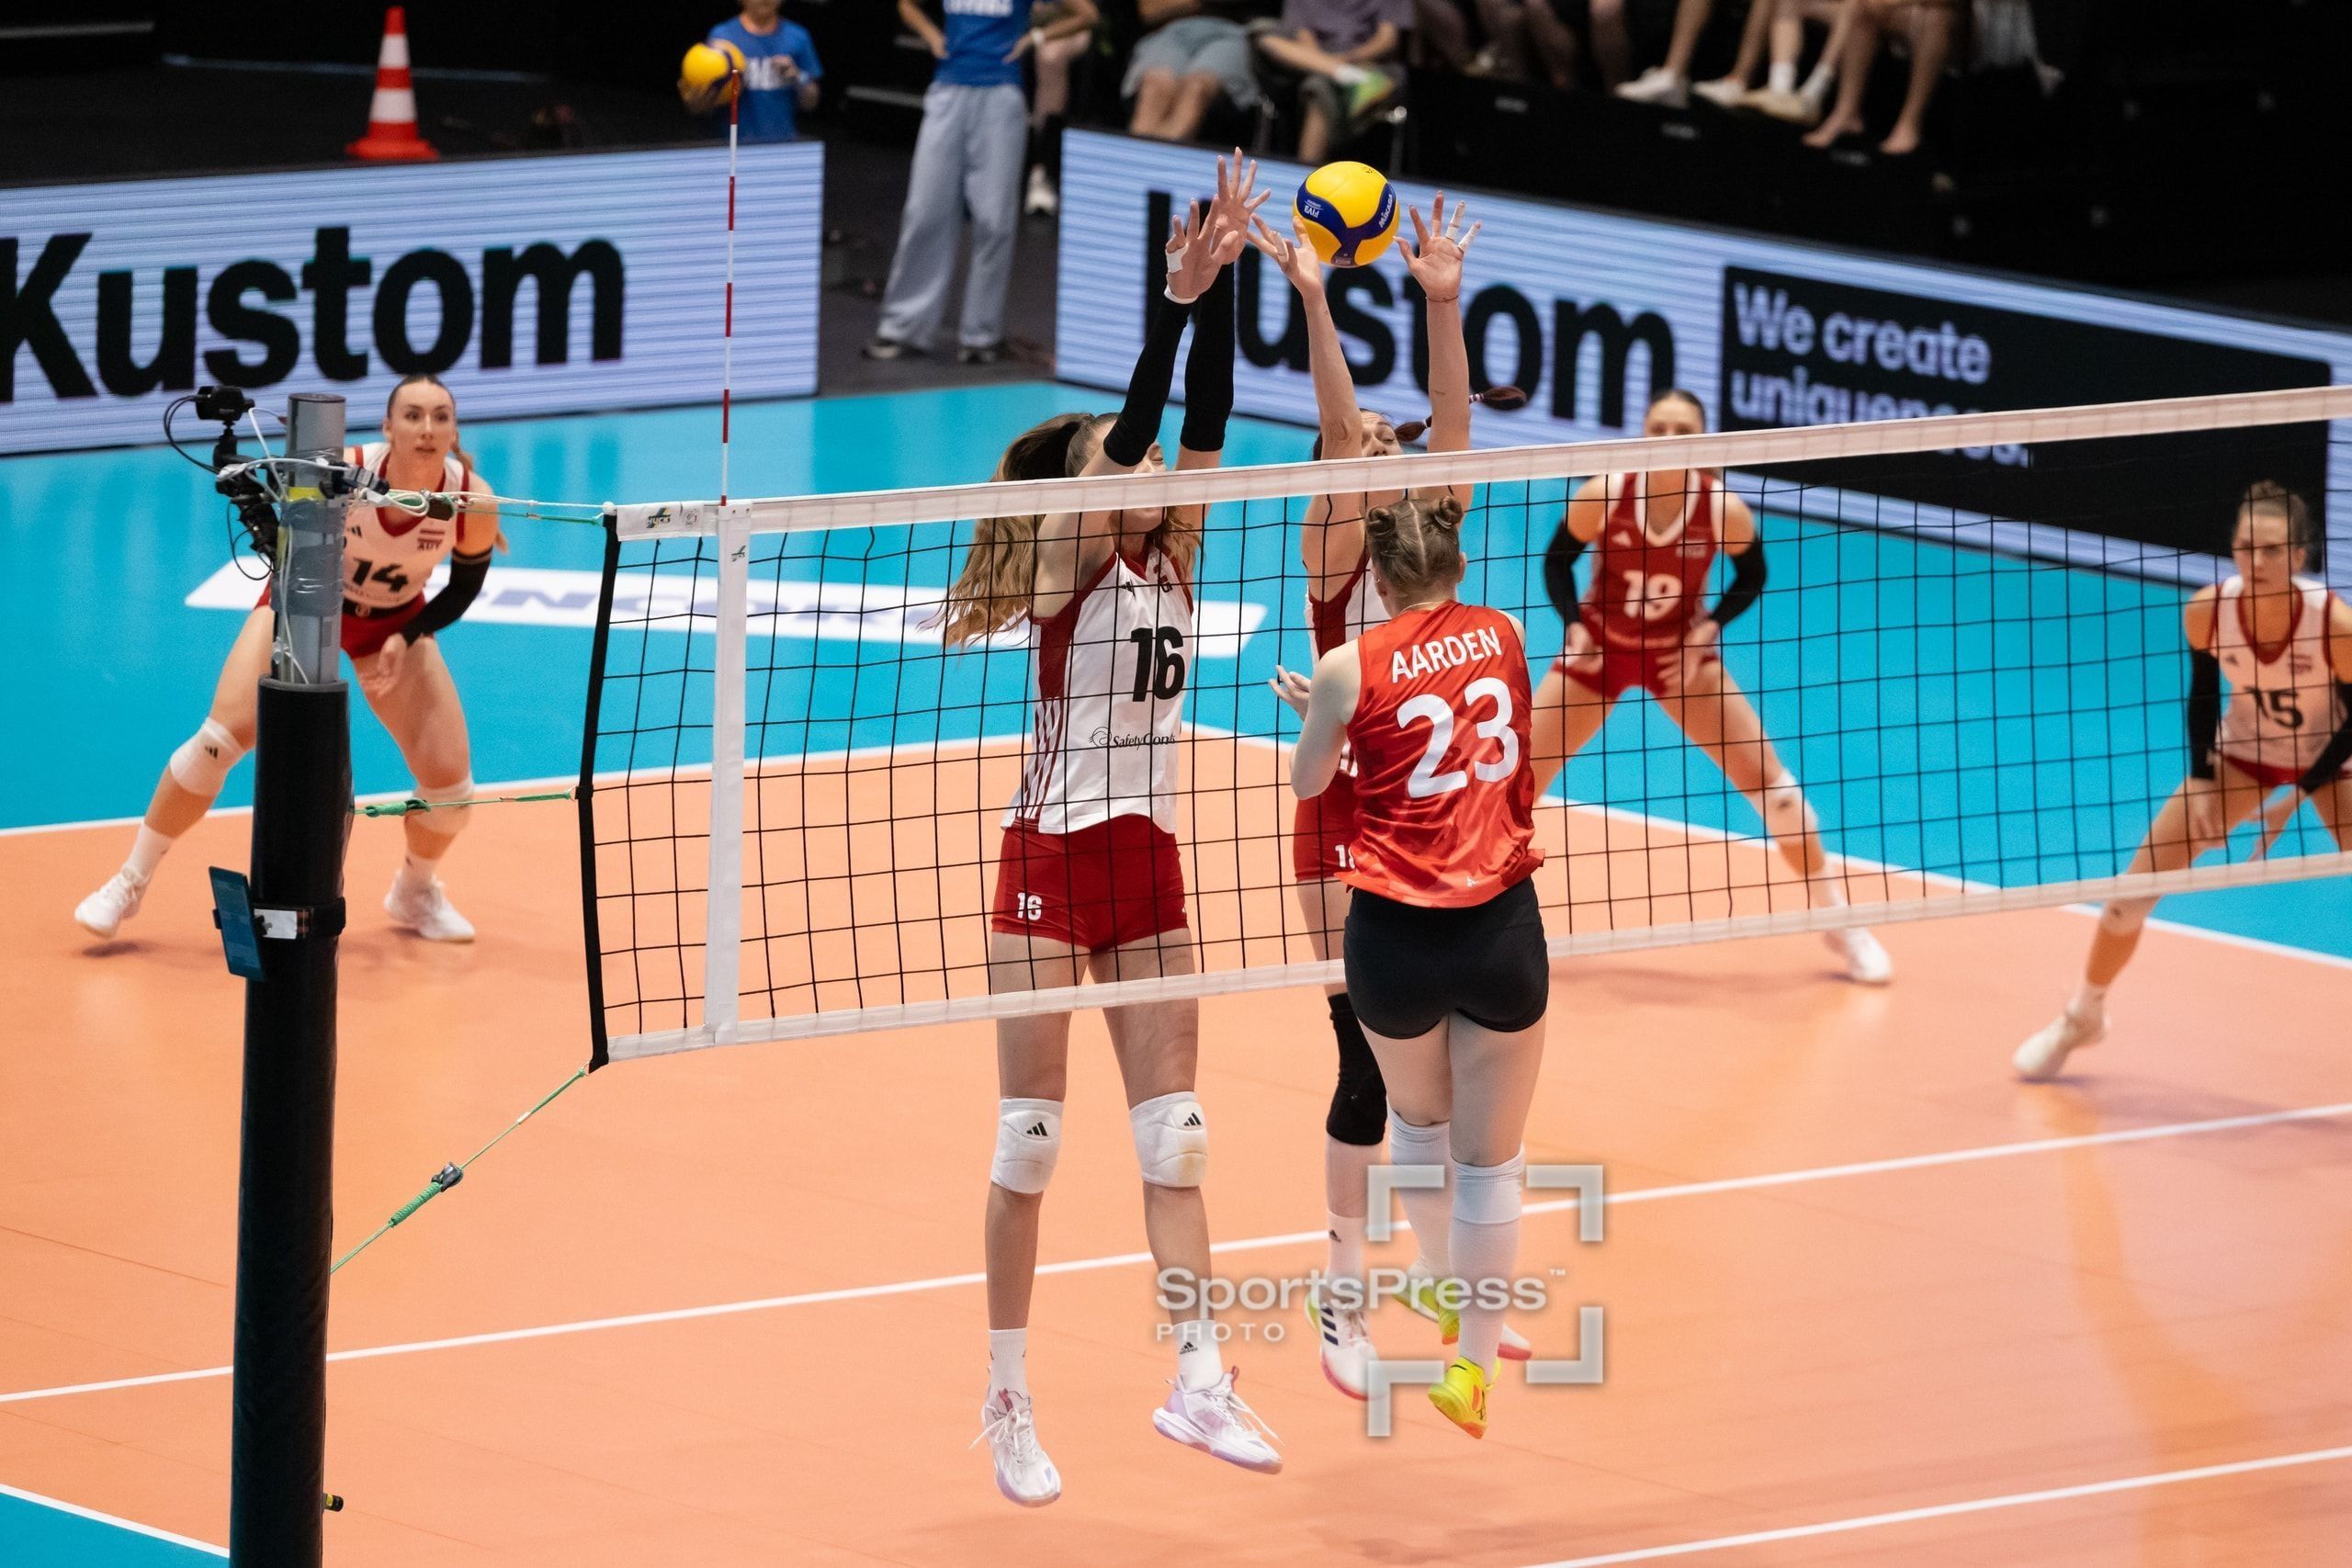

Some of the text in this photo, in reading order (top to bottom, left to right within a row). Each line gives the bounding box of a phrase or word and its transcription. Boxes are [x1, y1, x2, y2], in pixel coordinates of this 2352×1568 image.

[1304, 204, 1320, 219] FIVB
[0, 226, 625, 403] Kustom
[1733, 281, 1992, 384] We create
[353, 557, 408, 593] 14
[1623, 570, 1683, 622] 19
[1131, 626, 1185, 703] 16
[1392, 626, 1502, 683] AARDEN
[2244, 686, 2304, 729] 15
[1396, 677, 1520, 798] 23
[1017, 892, 1043, 920] 16
